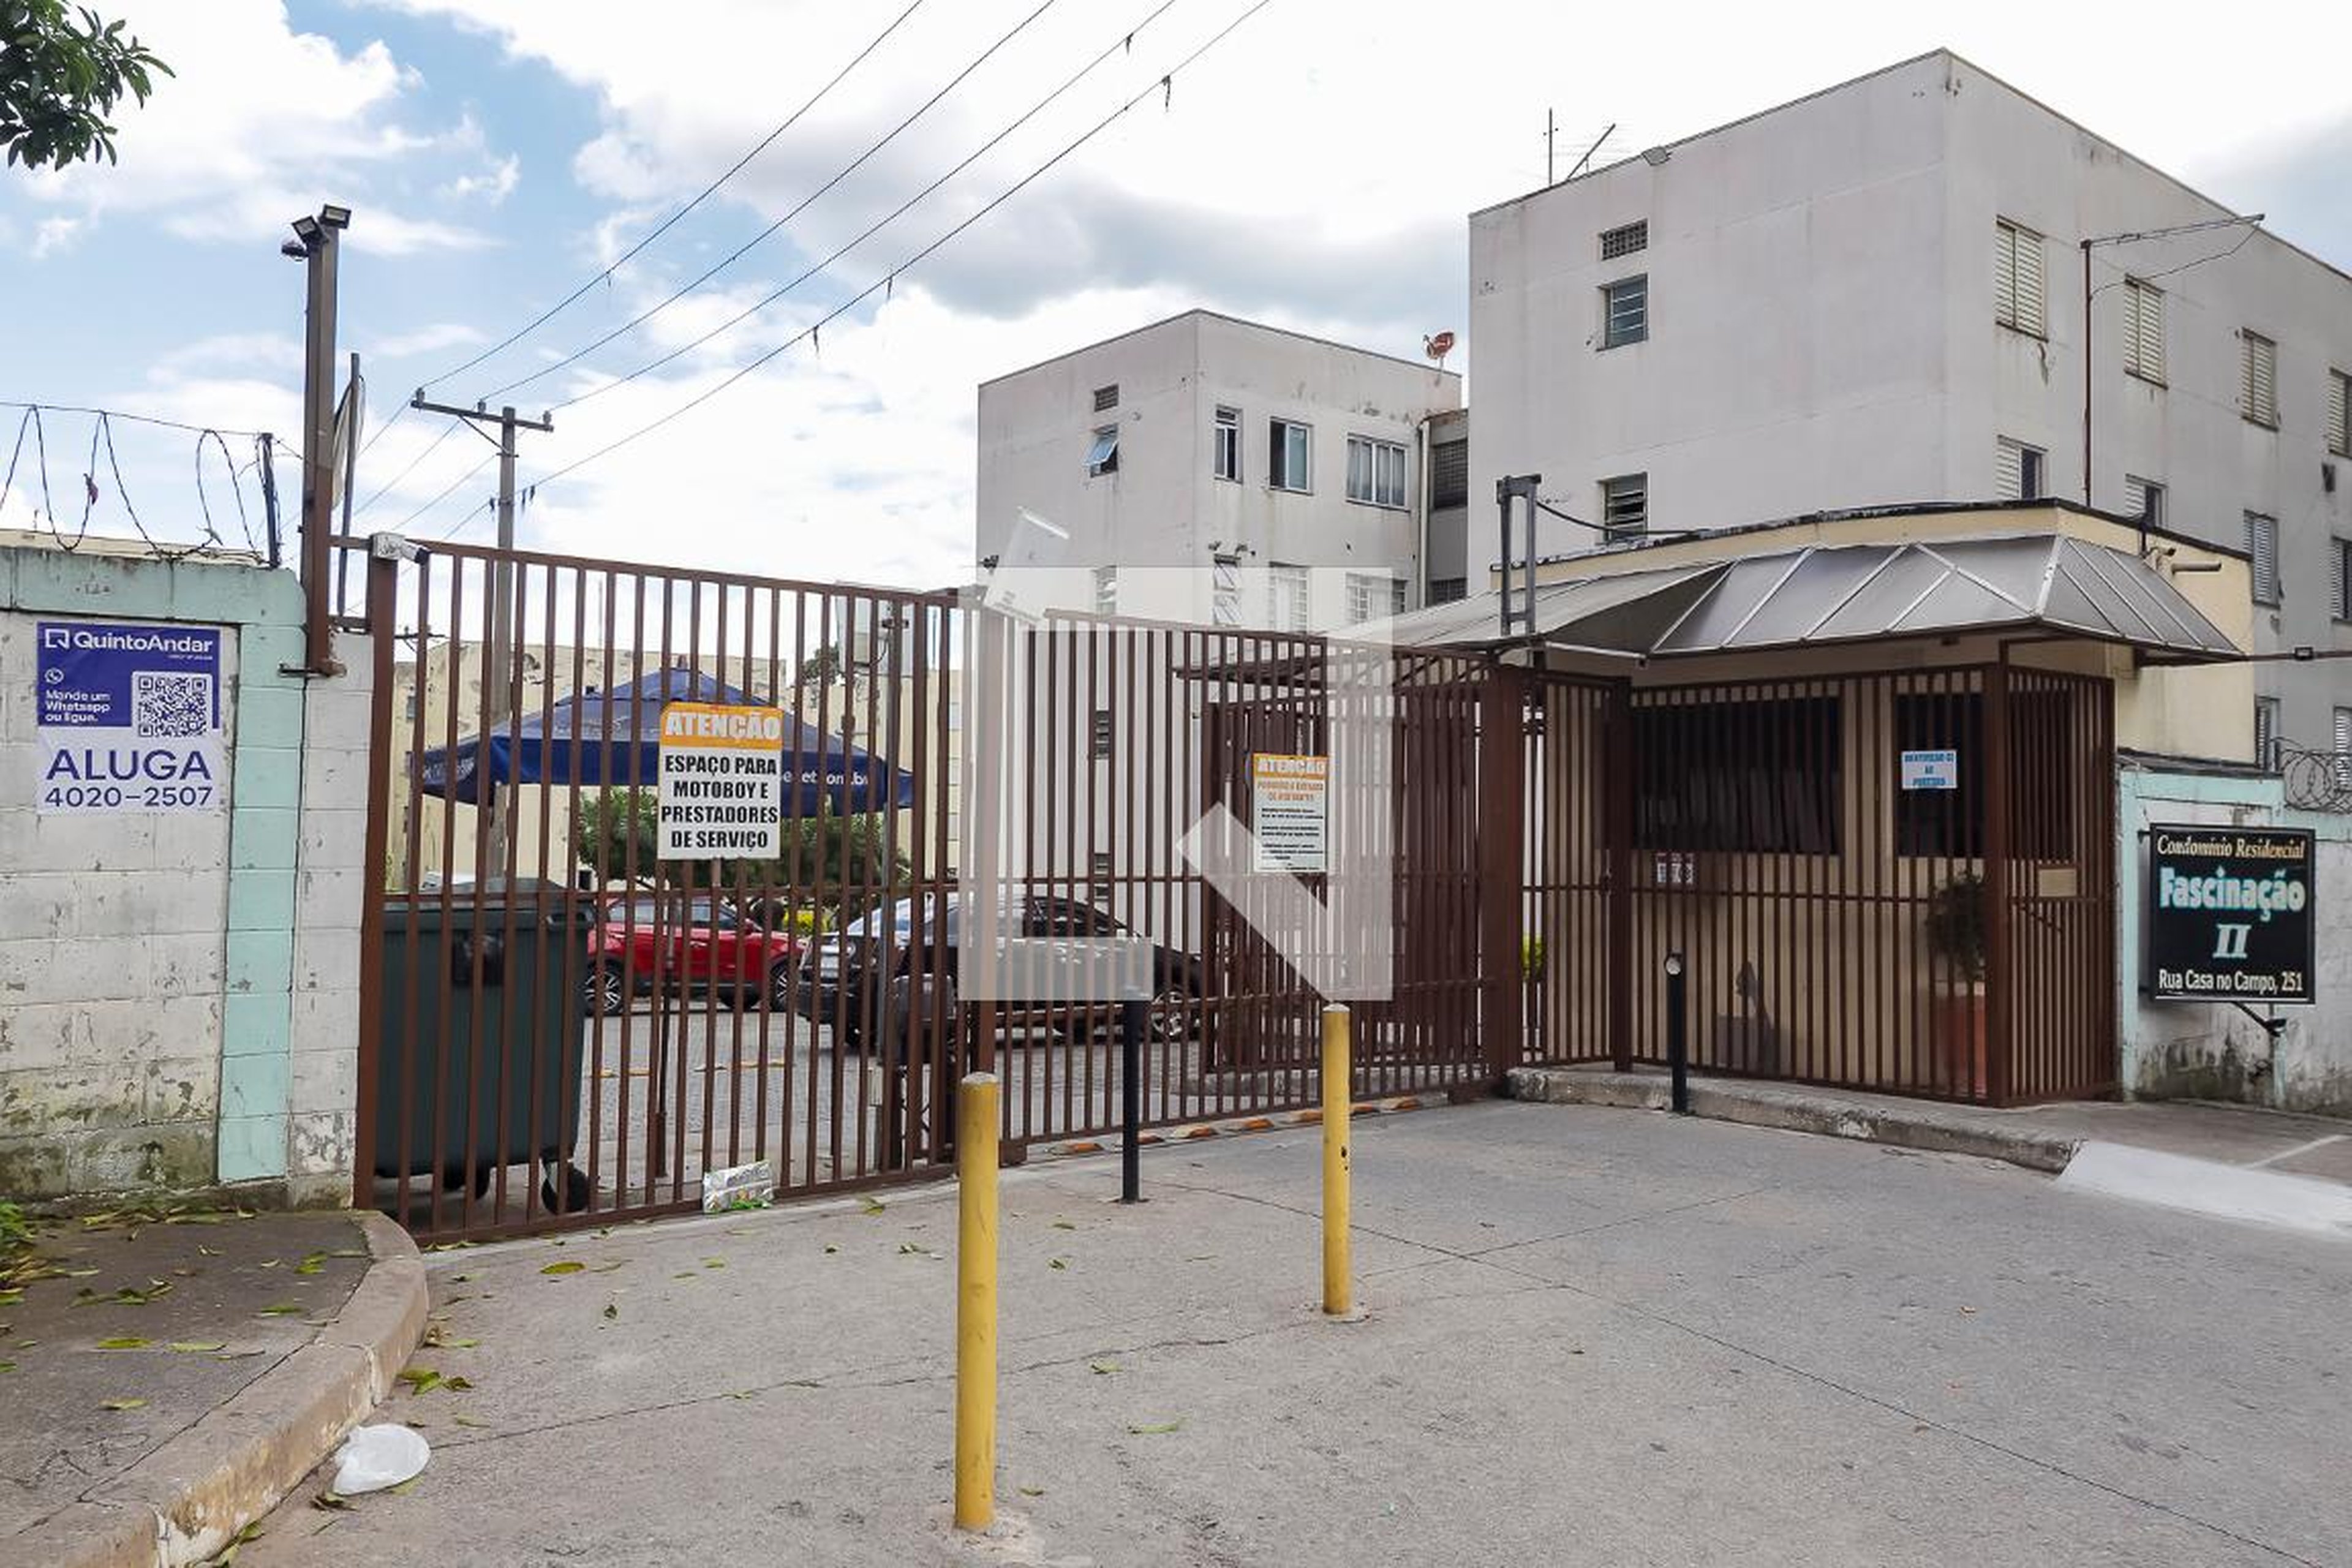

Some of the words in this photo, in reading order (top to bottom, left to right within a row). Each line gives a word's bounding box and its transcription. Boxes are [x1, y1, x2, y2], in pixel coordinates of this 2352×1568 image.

[74, 631, 213, 652] QuintoAndar
[665, 710, 781, 740] ATENÇÃO
[46, 749, 212, 781] ALUGA
[665, 755, 730, 776] ESPAÇO
[735, 757, 777, 775] PARA
[45, 787, 213, 807] 4020-2507
[674, 781, 756, 799] MOTOBOY
[761, 783, 769, 799] E
[662, 805, 778, 824] PRESTADORES
[671, 831, 692, 848] DE
[696, 831, 768, 852] SERVIÇO
[2235, 838, 2305, 859] Residencial
[2160, 865, 2305, 922] Fascinação
[2212, 924, 2252, 958] II
[2159, 969, 2183, 989] Rua
[2185, 970, 2214, 990] Casa
[2216, 977, 2233, 990] no
[2234, 971, 2278, 995] Campo,
[2281, 971, 2304, 992] 251
